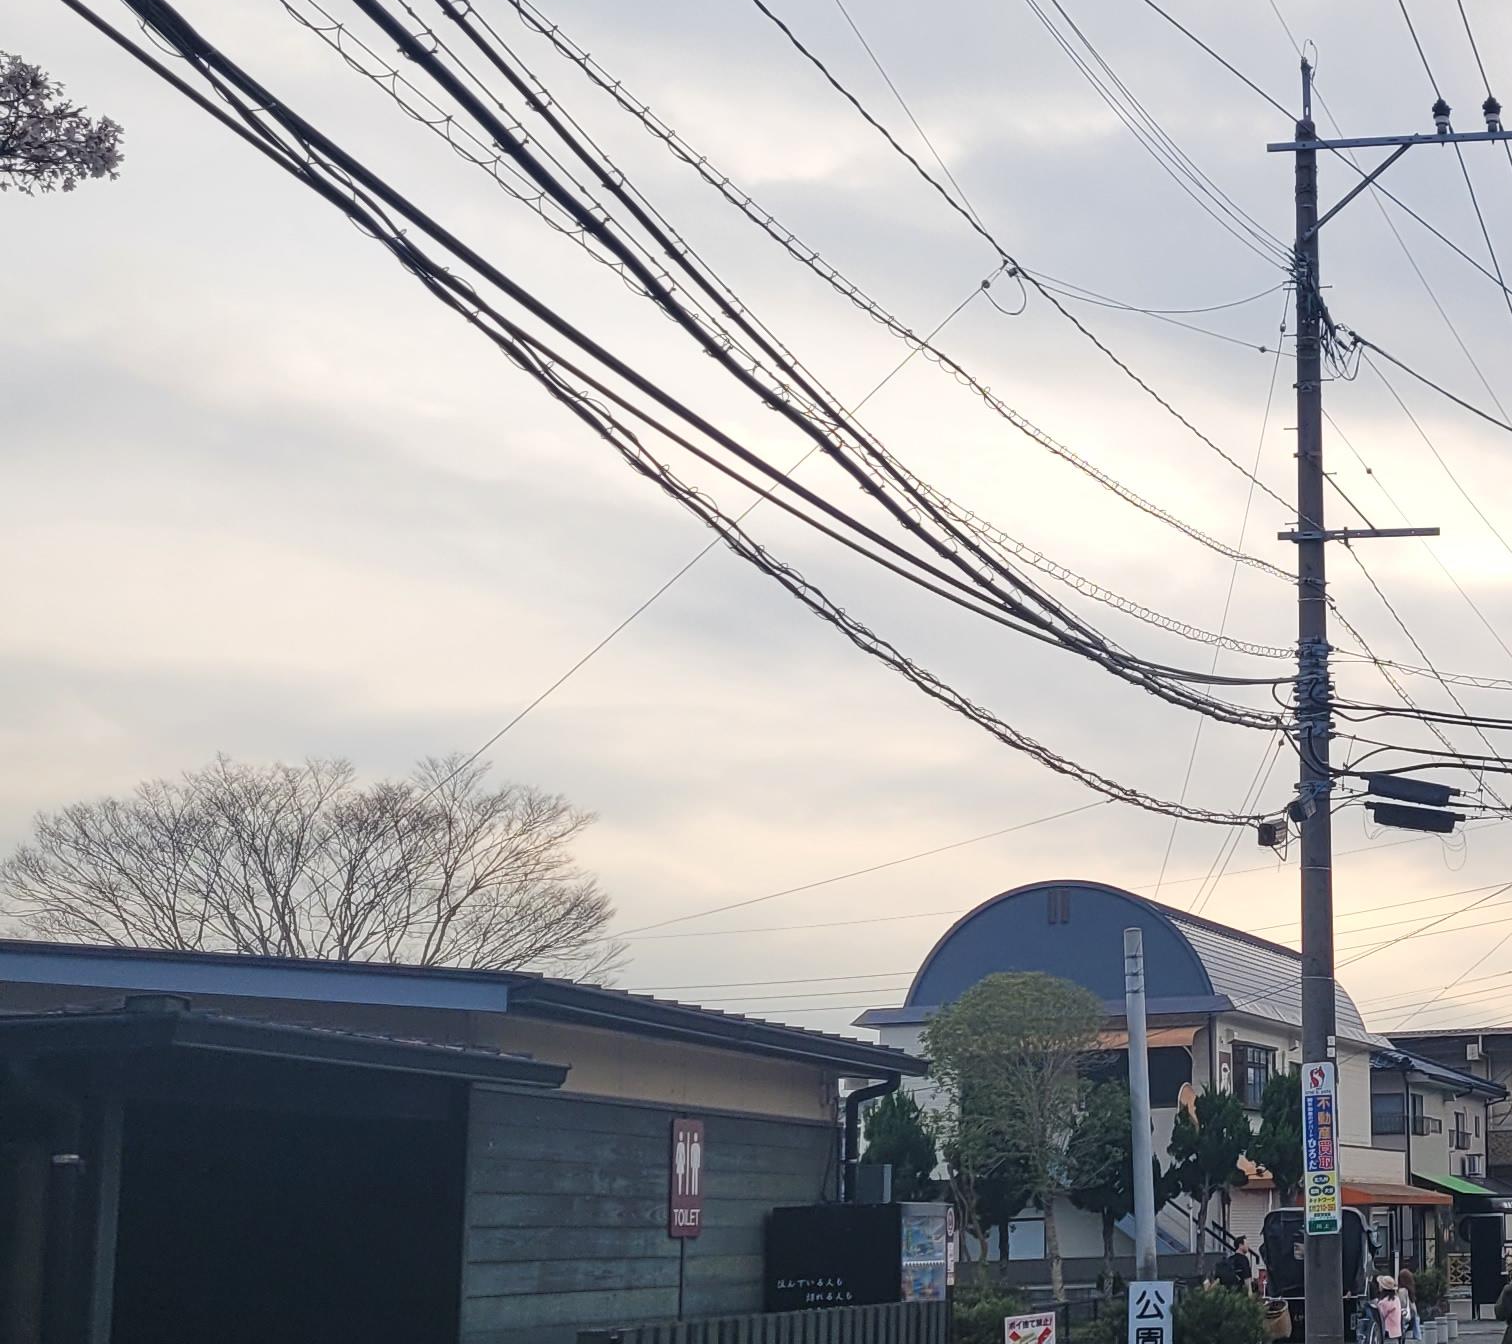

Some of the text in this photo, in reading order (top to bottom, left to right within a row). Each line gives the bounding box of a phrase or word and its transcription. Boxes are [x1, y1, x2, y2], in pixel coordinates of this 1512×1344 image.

[1316, 1097, 1334, 1170] 不動産買取
[673, 1208, 701, 1227] TOILET
